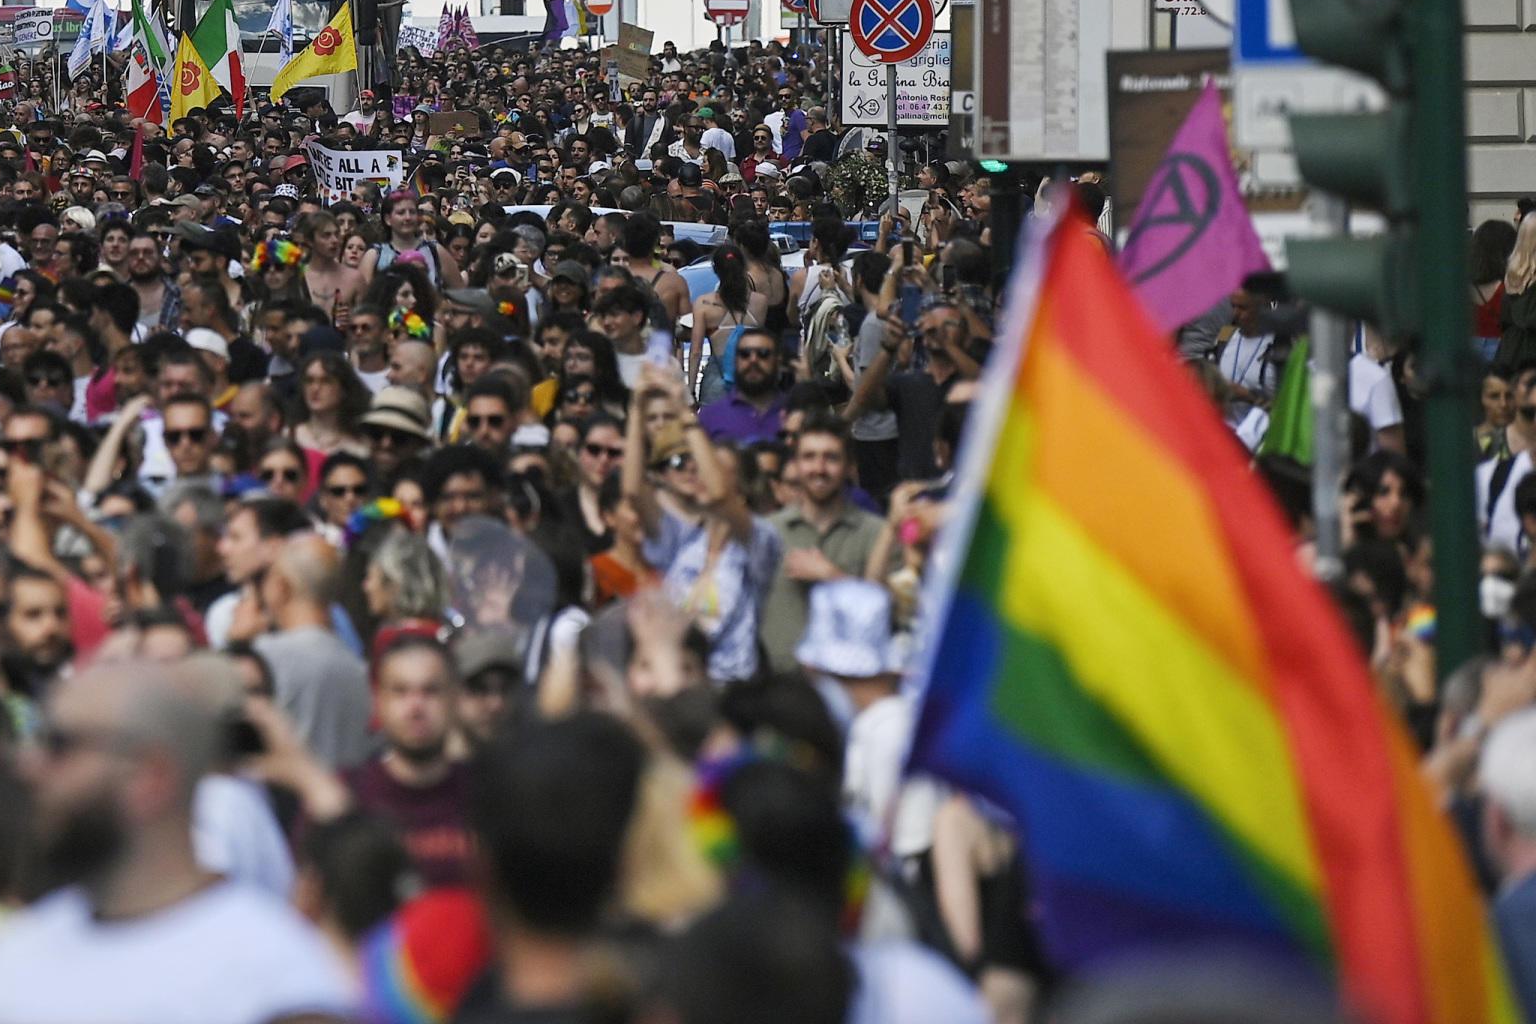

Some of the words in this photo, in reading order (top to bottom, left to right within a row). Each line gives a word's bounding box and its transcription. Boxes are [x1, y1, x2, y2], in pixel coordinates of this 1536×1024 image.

[339, 158, 363, 173] ALL
[371, 158, 380, 173] A
[335, 176, 354, 191] BIT
